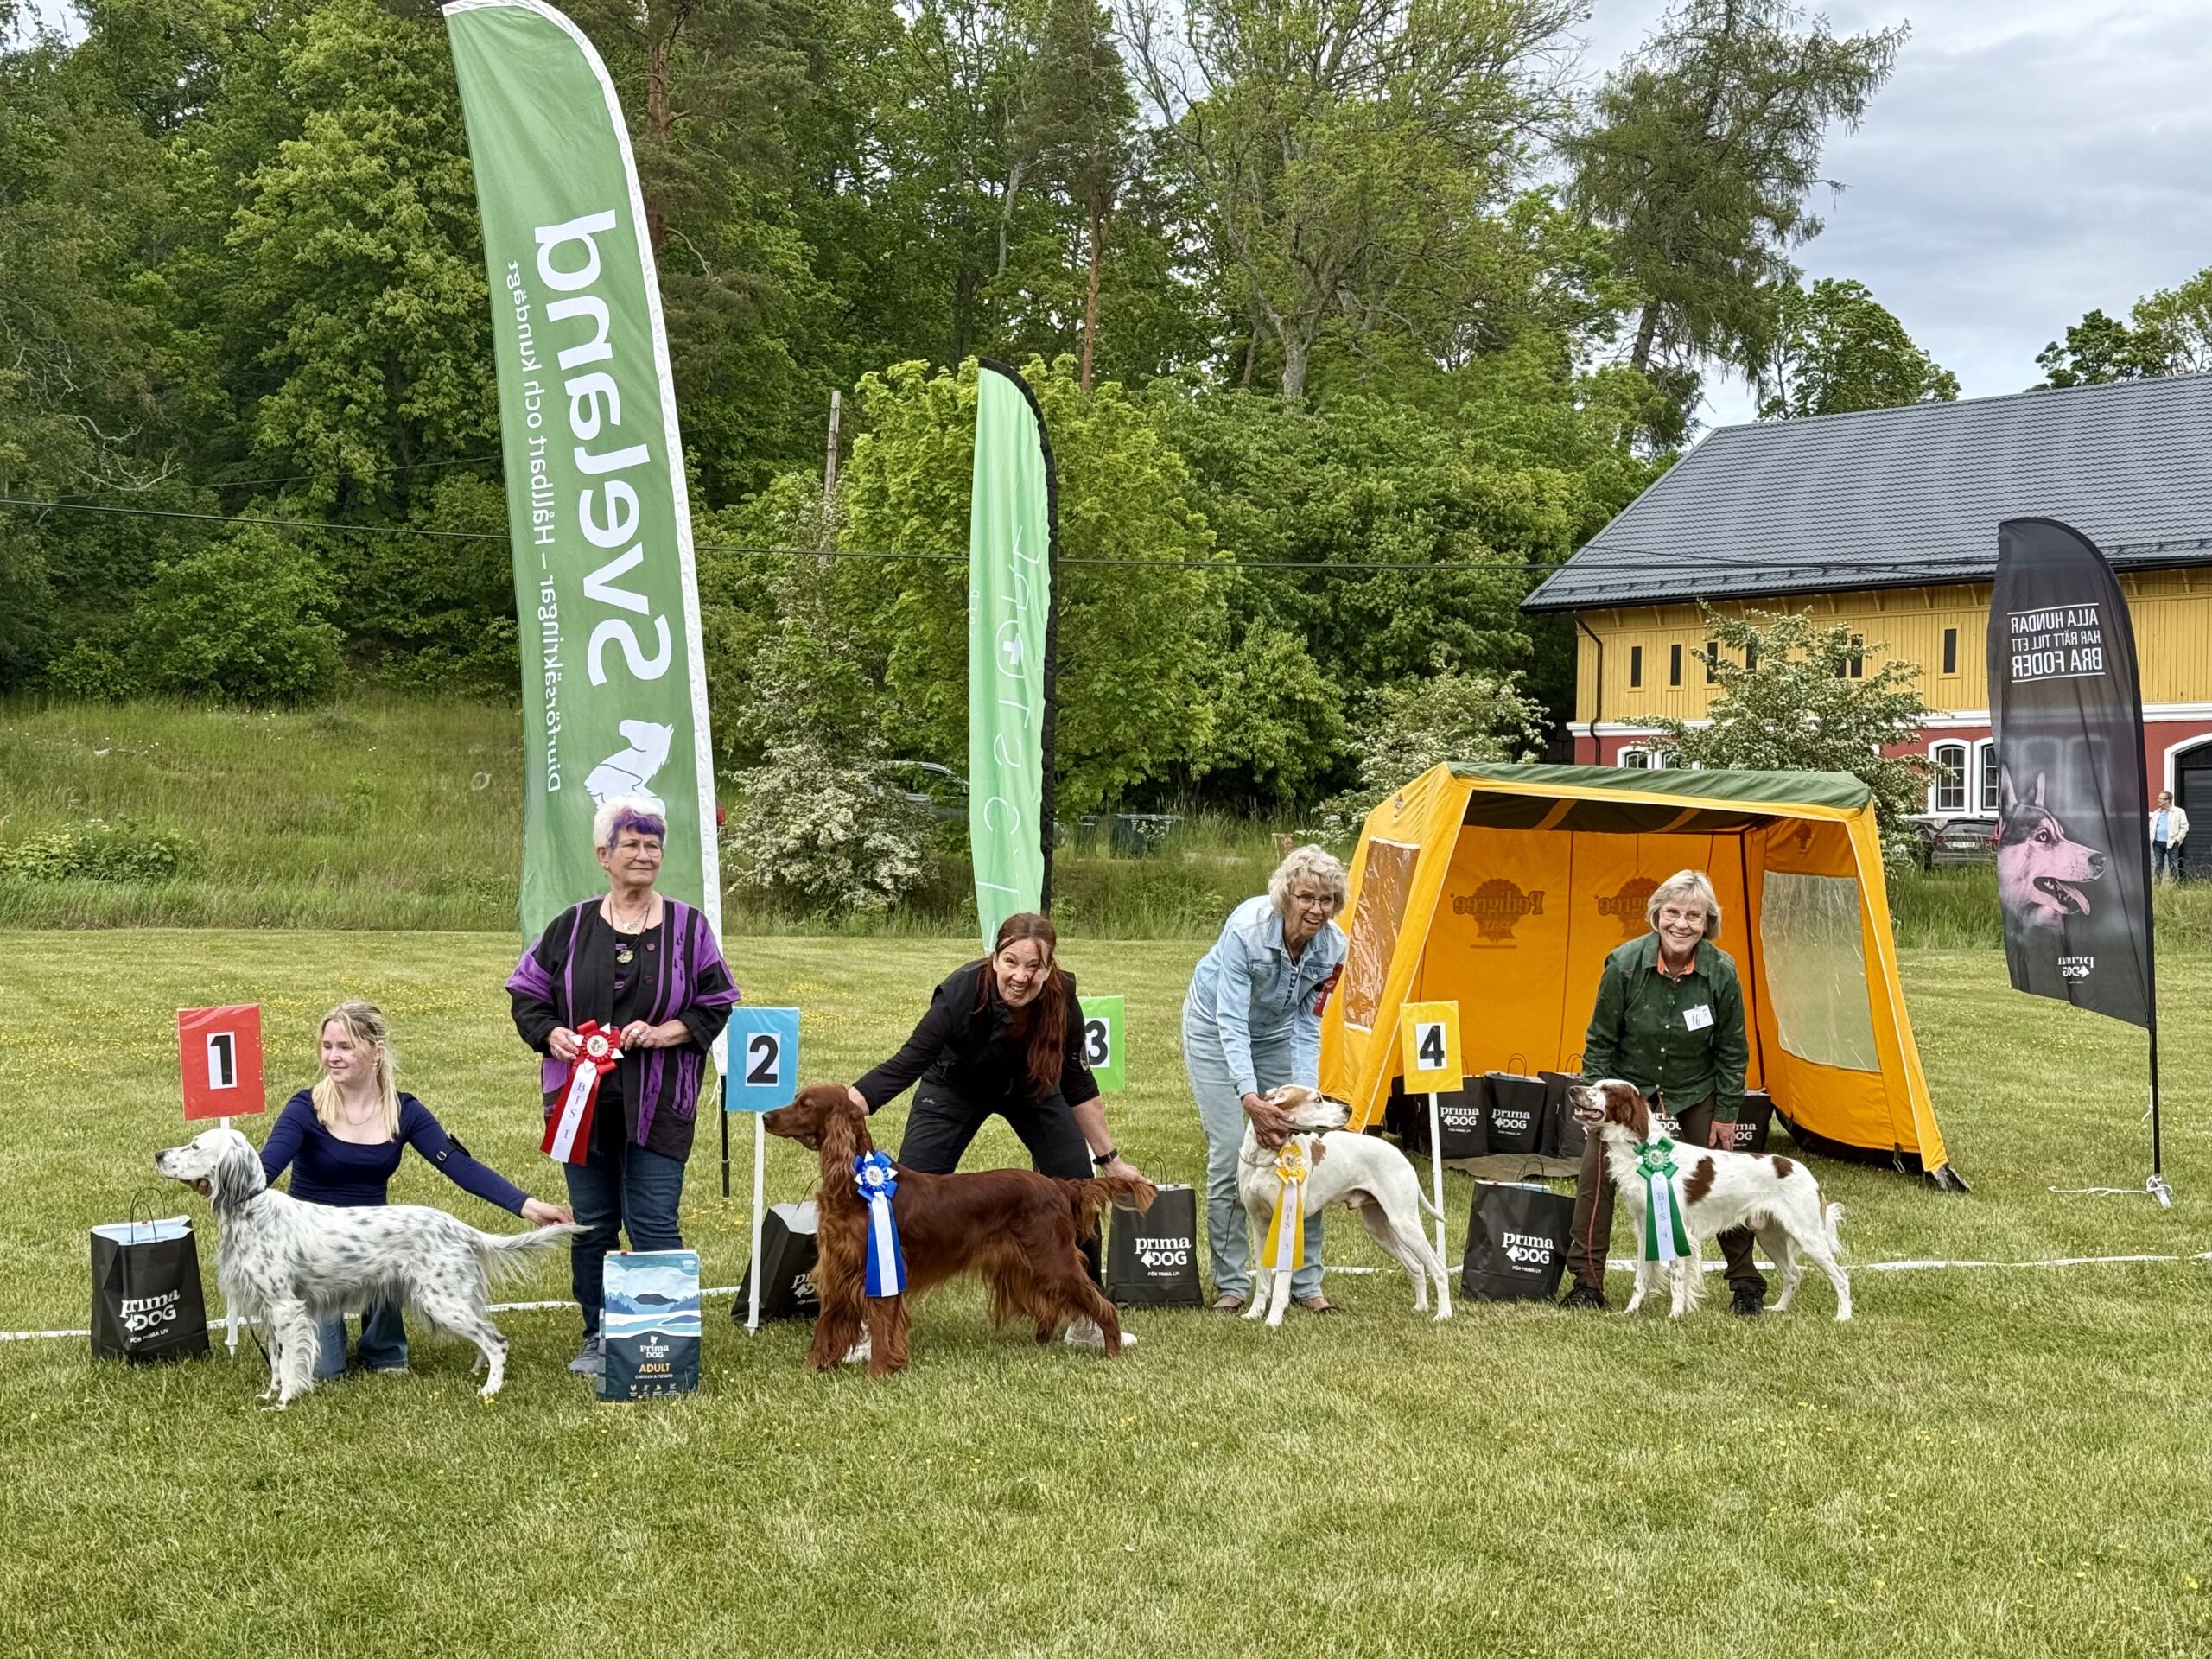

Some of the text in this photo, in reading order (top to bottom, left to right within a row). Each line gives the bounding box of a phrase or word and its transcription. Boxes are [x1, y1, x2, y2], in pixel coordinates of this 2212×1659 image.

[1084, 1020, 1109, 1065] 3
[1420, 1025, 1445, 1067] 4
[210, 1034, 233, 1085] 1
[747, 1034, 779, 1084] 2
[1440, 1106, 1480, 1118] prima
[1491, 1108, 1531, 1120] prima
[1452, 1116, 1478, 1127] DOG
[1502, 1118, 1528, 1130] DOG
[1735, 1131, 1753, 1141] OG
[1656, 1192, 1667, 1222] BIS
[1134, 1236, 1192, 1255] prima
[1501, 1231, 1554, 1249] prima
[1151, 1250, 1188, 1267] DOG
[1517, 1247, 1550, 1265] DOG
[134, 1304, 177, 1332] DOG
[639, 1344, 670, 1353] Prima
[639, 1363, 671, 1373] ADULT
